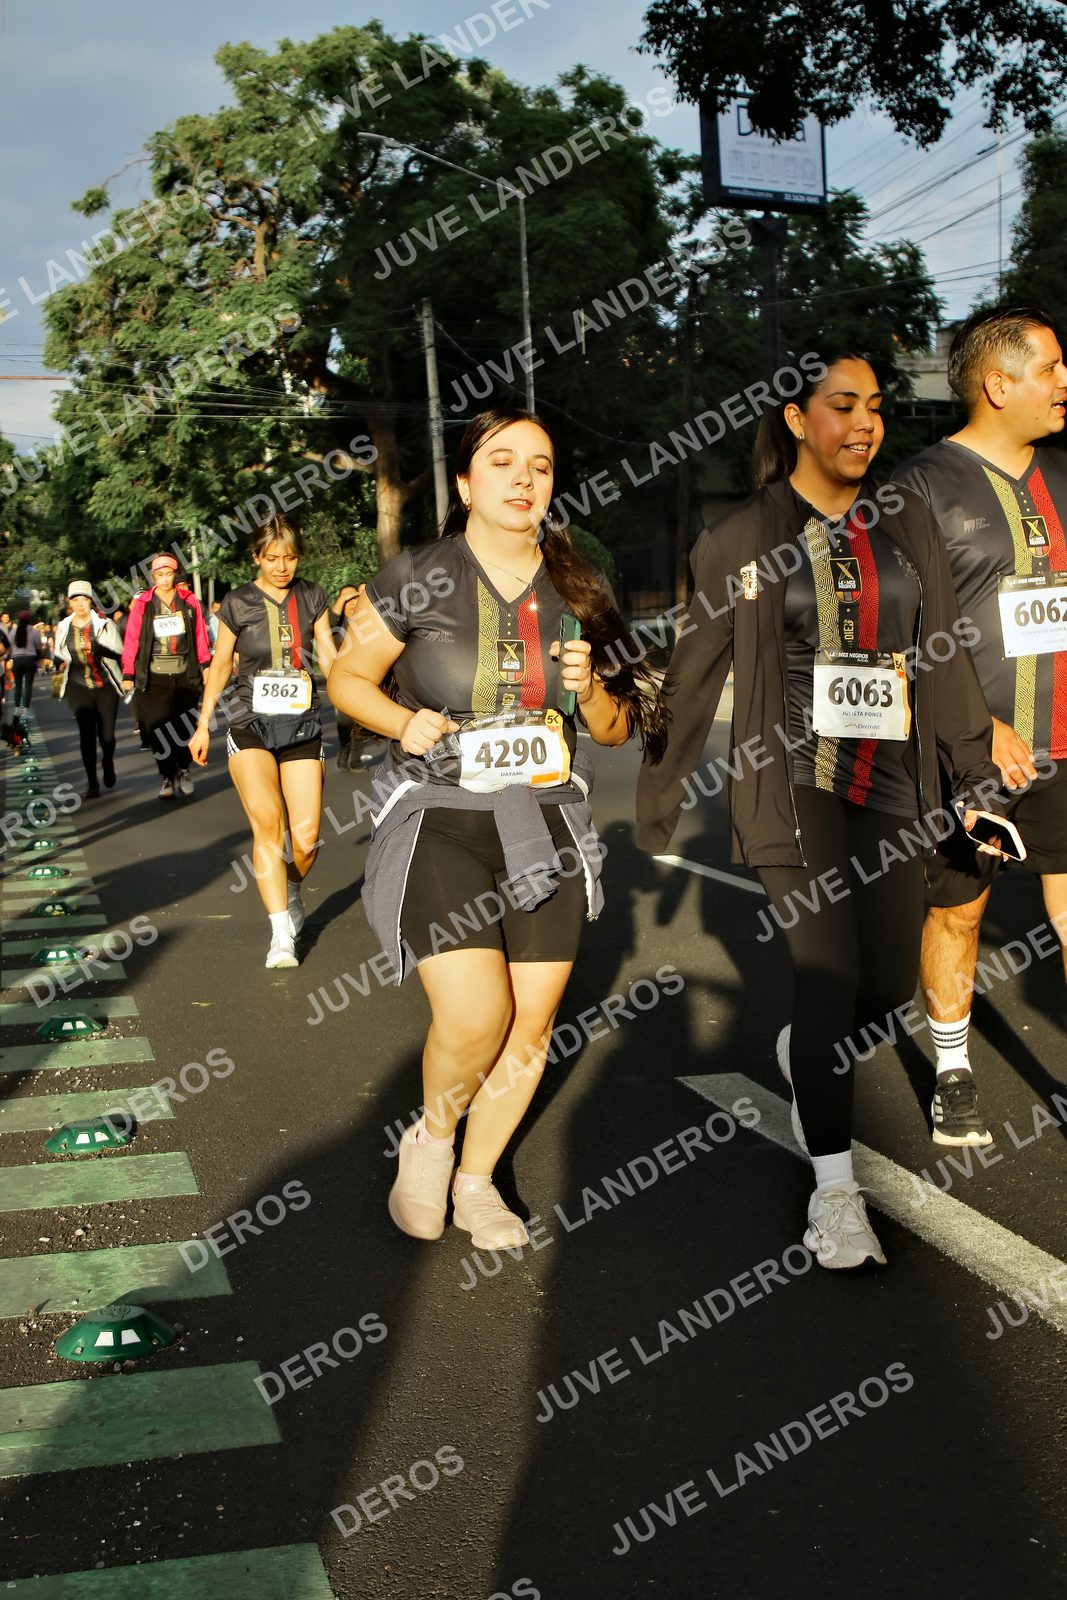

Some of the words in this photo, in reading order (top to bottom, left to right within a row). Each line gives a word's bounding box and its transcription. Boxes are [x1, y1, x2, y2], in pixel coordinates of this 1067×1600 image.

[261, 683, 299, 698] 5862
[828, 676, 894, 708] 6063
[547, 714, 559, 724] 5K
[475, 736, 547, 769] 4290
